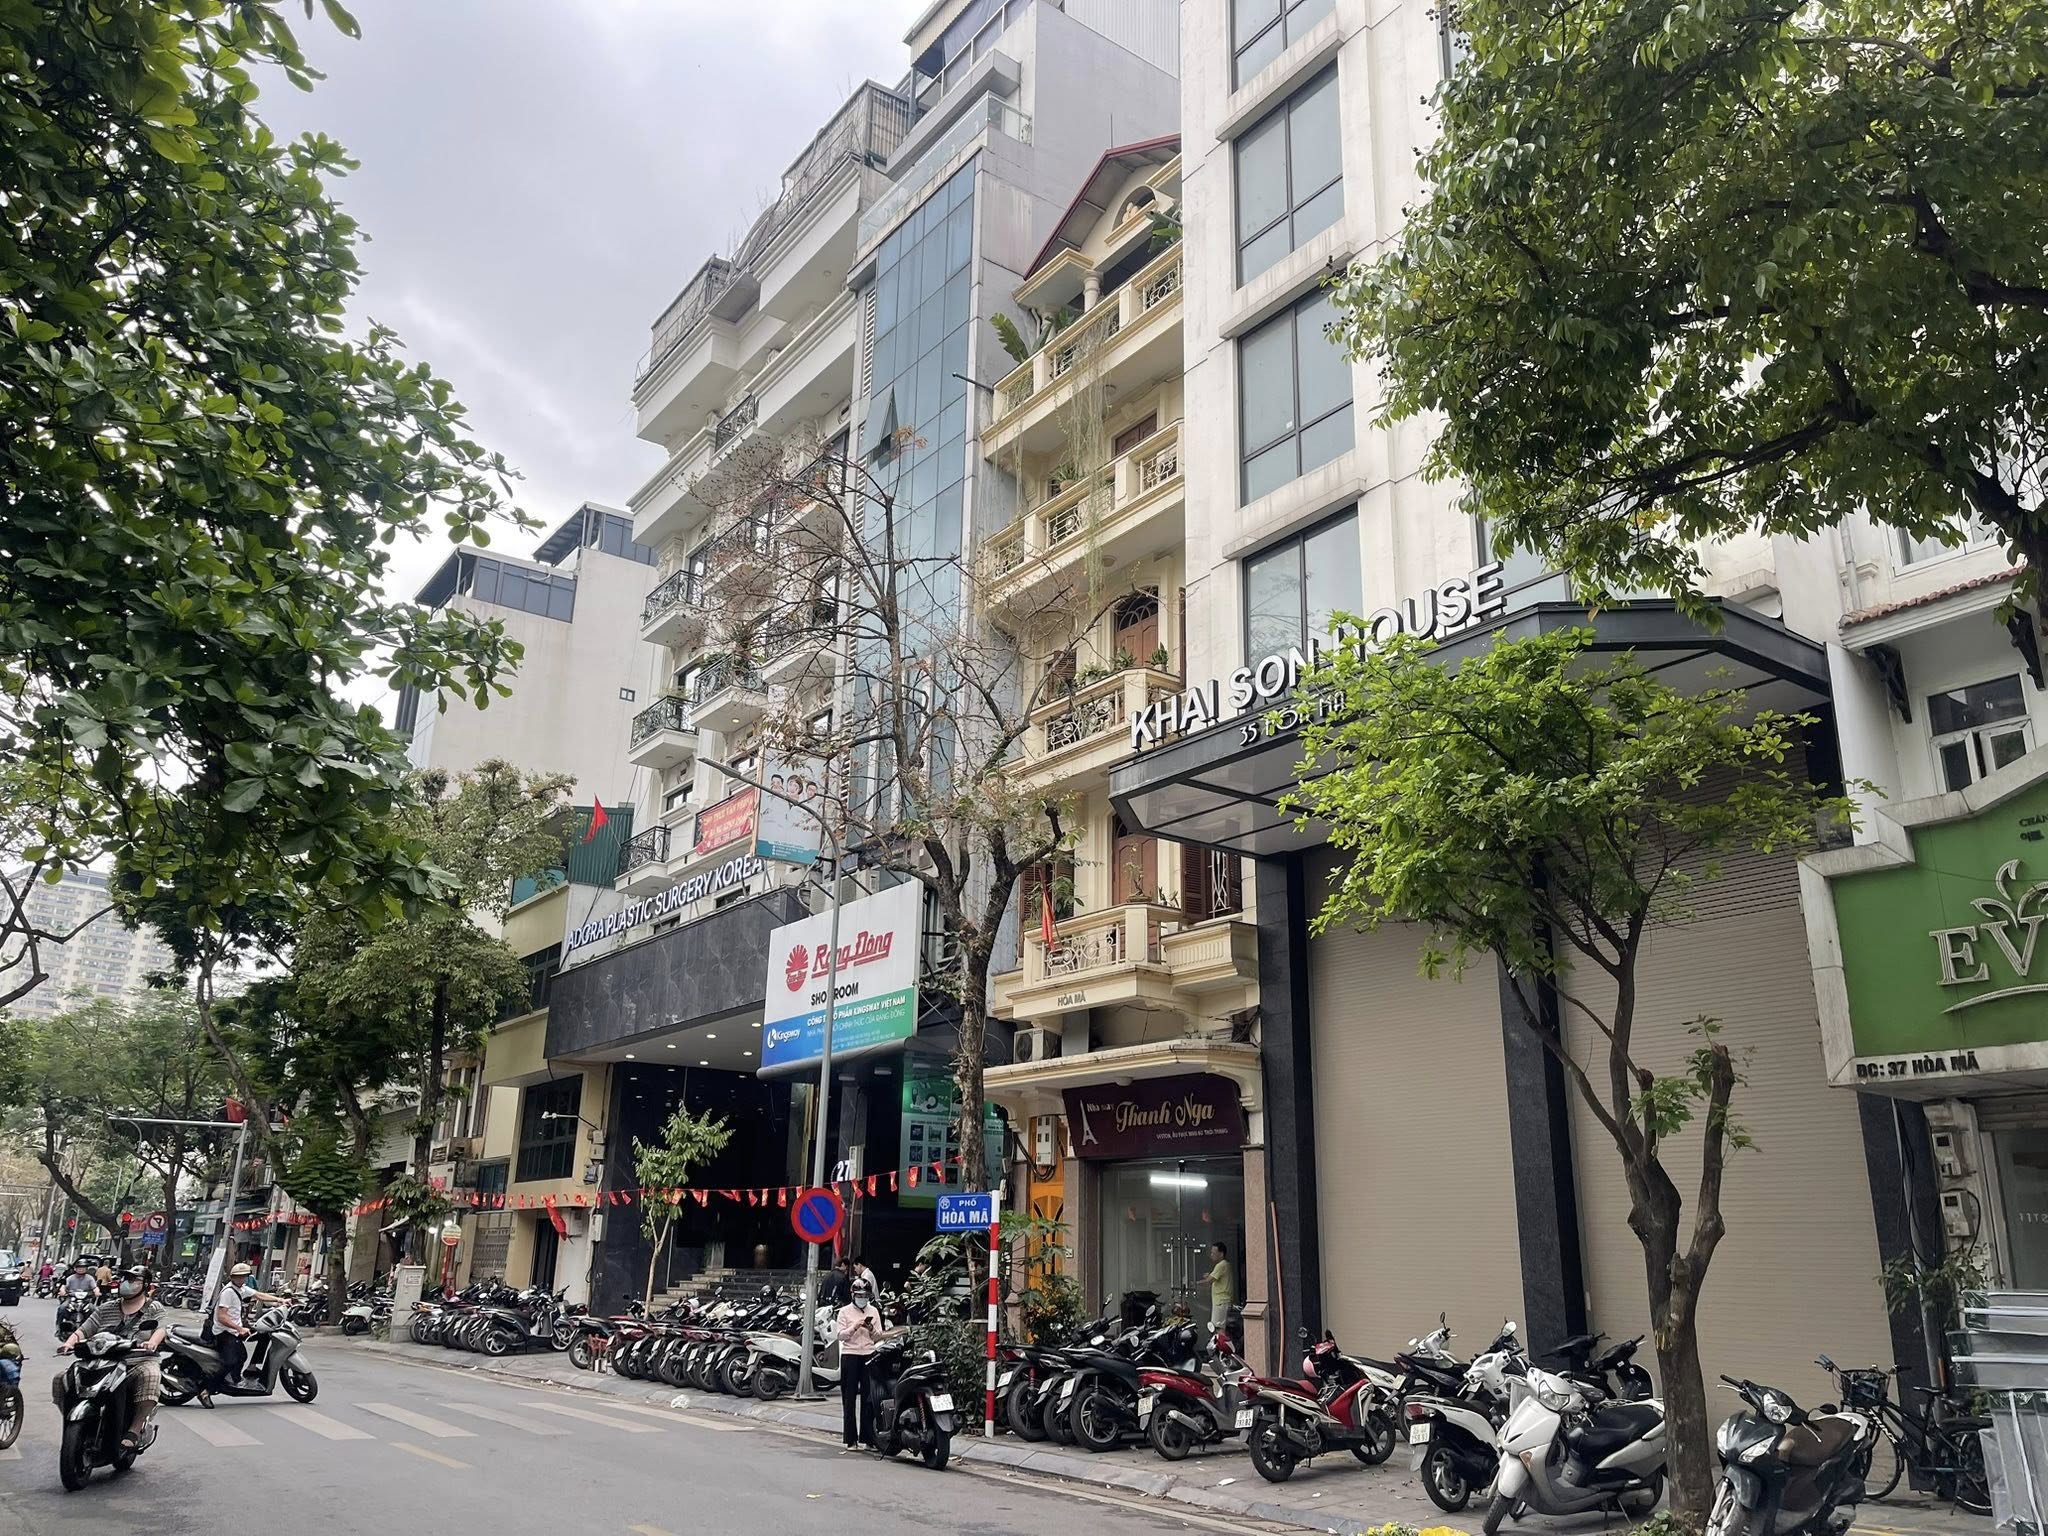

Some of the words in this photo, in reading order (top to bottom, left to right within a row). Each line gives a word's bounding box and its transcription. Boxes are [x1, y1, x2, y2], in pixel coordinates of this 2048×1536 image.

[1131, 679, 1220, 749] KHAI
[1228, 637, 1319, 710] SON
[1240, 722, 1259, 746] 35
[566, 918, 605, 950] ADORA
[605, 897, 653, 936] PLASTIC
[654, 870, 713, 915] SURGERY
[714, 853, 764, 890] KOREA
[853, 930, 894, 966] Đông
[1929, 914, 2048, 985] EV
[811, 982, 859, 1006] SHOROOM
[807, 1016, 823, 1027] CÔNG
[854, 1004, 880, 1016] KINGSWAY
[880, 997, 893, 1009] VIỆT
[893, 995, 906, 1005] NAM
[1888, 1060, 1907, 1076] 37
[1912, 1055, 1947, 1075] HÒA
[1950, 1050, 1980, 1072] MÃ
[1115, 1101, 1171, 1132] Thanh
[1175, 1092, 1216, 1126] Nga
[942, 1208, 966, 1224] HÒA
[969, 1207, 989, 1224] MÃ
[958, 1198, 977, 1207] PHỐ
